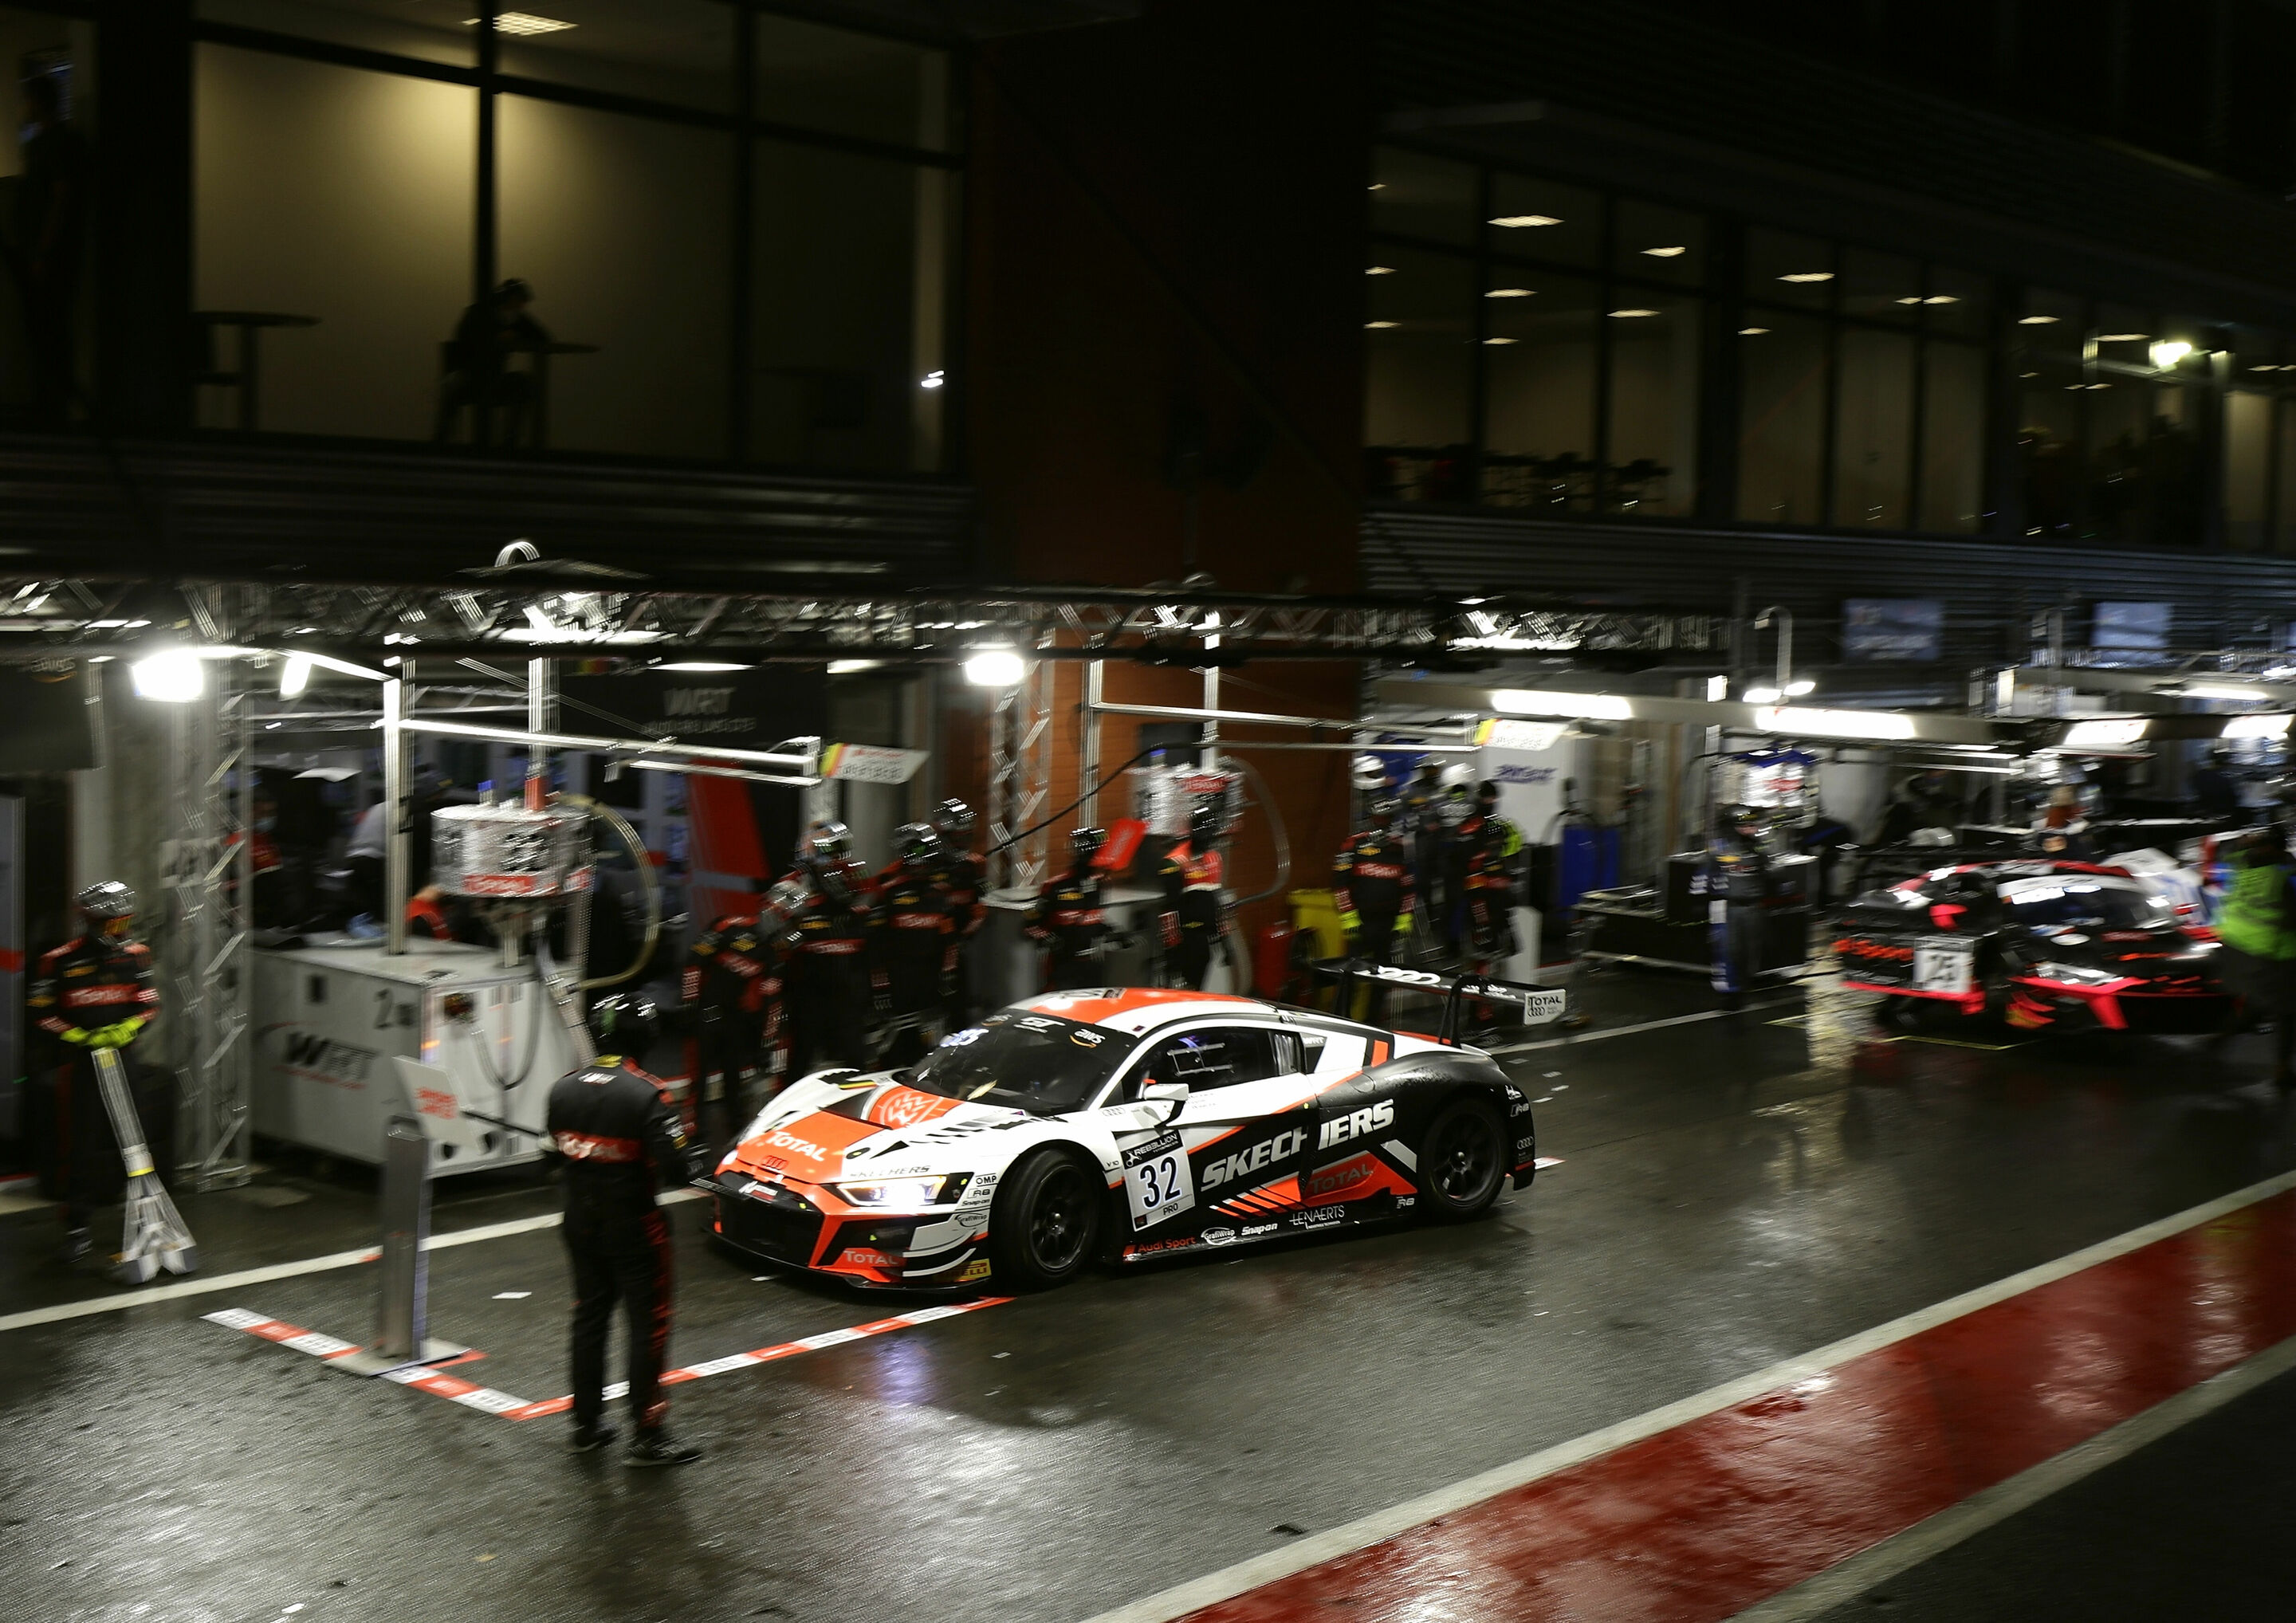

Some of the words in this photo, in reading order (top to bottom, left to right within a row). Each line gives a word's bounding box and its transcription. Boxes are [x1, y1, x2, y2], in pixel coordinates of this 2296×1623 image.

[1528, 996, 1563, 1008] TOTAL
[1075, 1028, 1106, 1044] aws
[1514, 1103, 1530, 1116] R8
[766, 1131, 828, 1161] TOTAL
[1134, 1134, 1178, 1156] REBELLION
[1201, 1099, 1394, 1192] SKECHERS
[976, 1175, 997, 1185] OMP
[1140, 1157, 1181, 1208] 32
[1311, 1164, 1374, 1194] TOTAL
[1162, 1203, 1179, 1216] PRO
[1397, 1197, 1415, 1209] R8
[1289, 1204, 1346, 1228] LENAERTS
[1138, 1242, 1163, 1254] Audi
[1166, 1236, 1197, 1252] Sport
[843, 1250, 900, 1265] TOTAL
